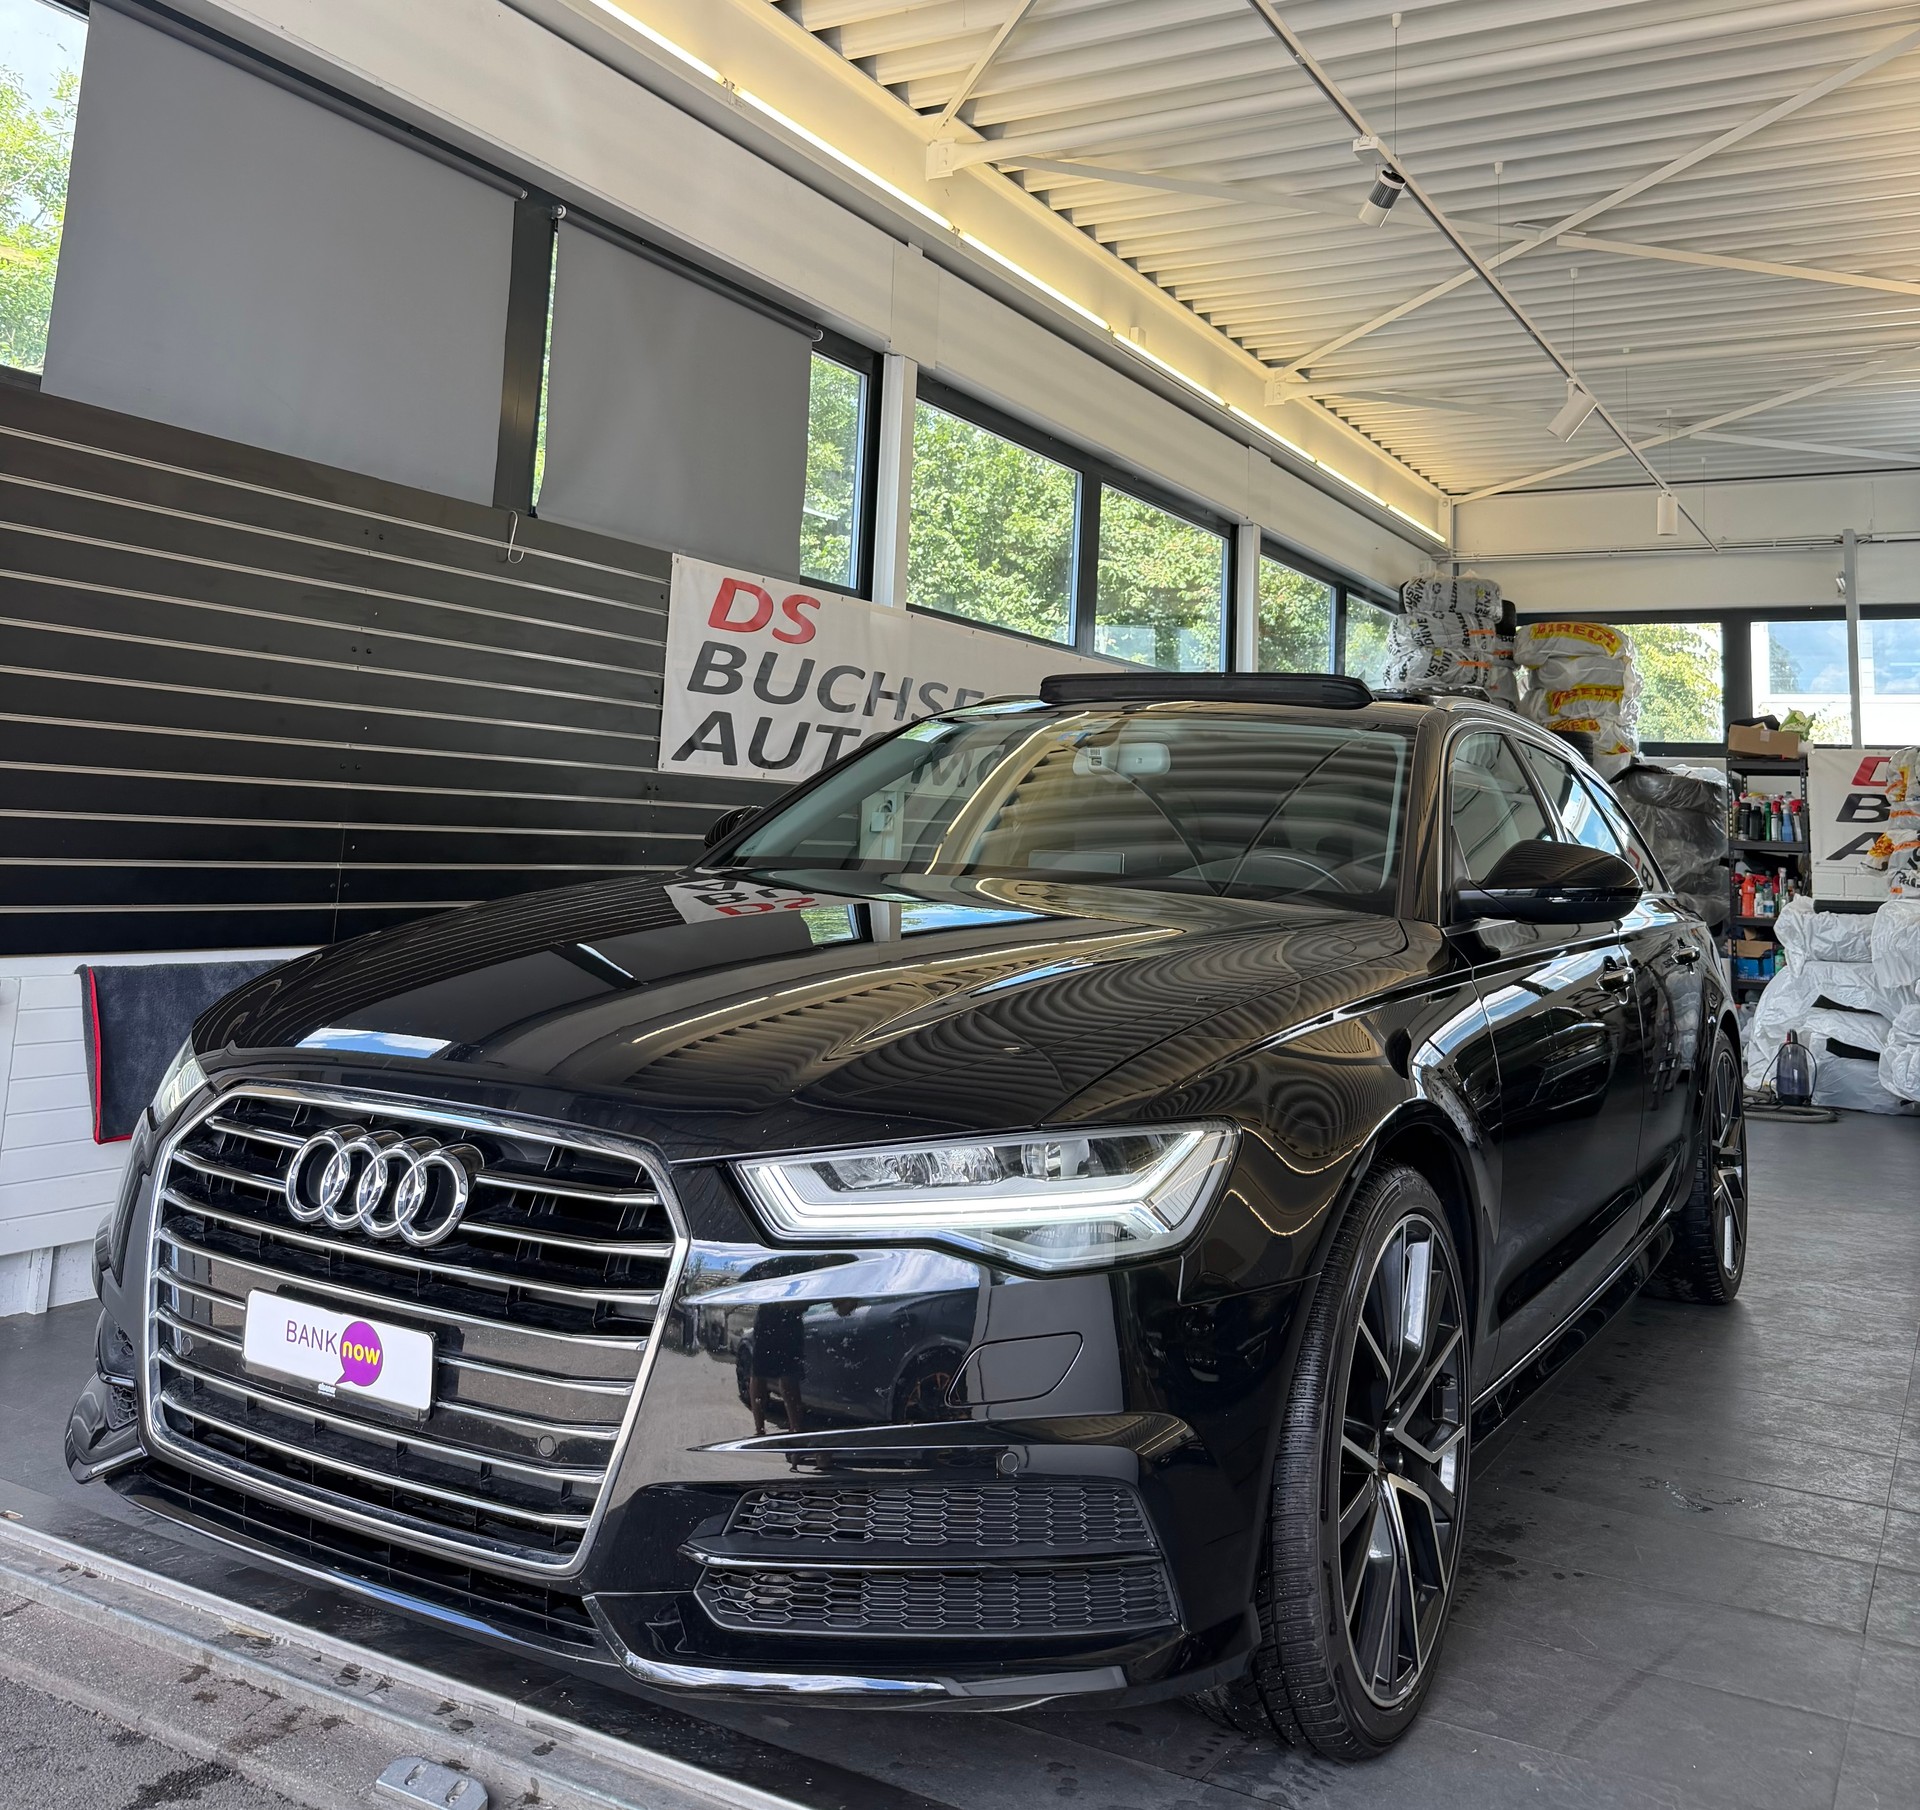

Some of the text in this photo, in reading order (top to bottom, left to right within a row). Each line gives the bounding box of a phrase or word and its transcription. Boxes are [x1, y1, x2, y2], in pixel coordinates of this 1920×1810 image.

[707, 577, 821, 644] DS
[286, 1320, 381, 1366] BANK now
